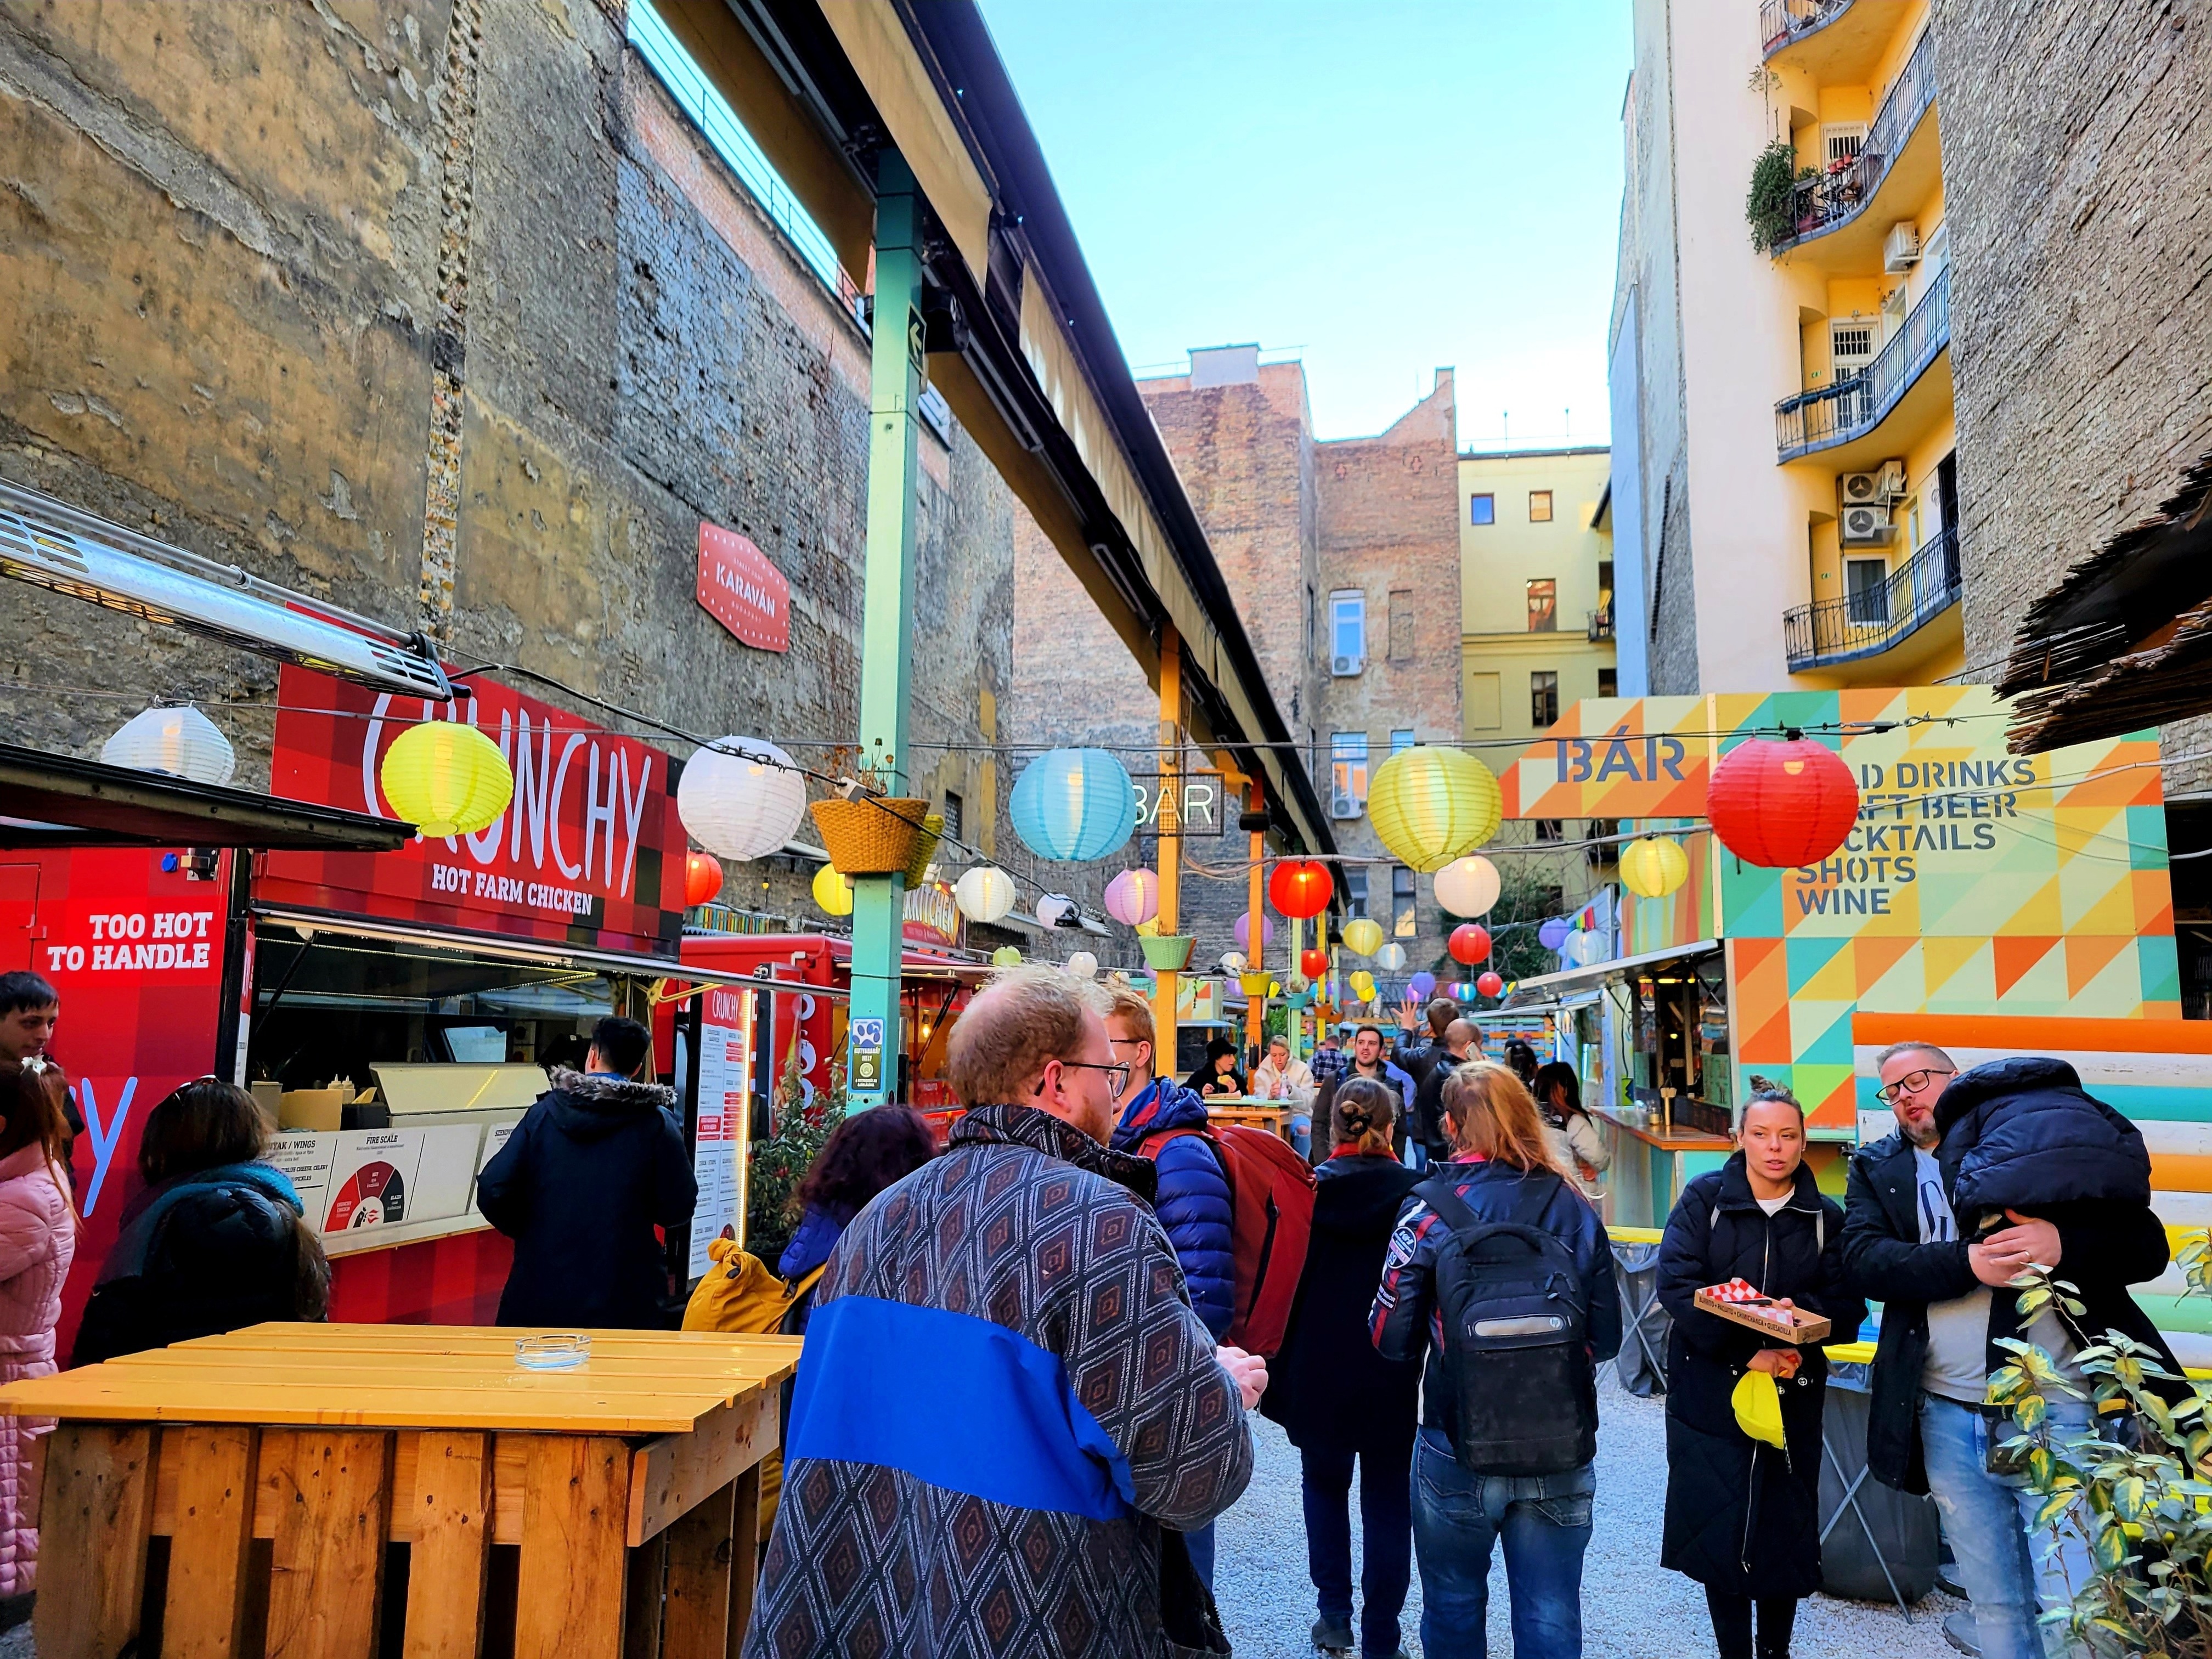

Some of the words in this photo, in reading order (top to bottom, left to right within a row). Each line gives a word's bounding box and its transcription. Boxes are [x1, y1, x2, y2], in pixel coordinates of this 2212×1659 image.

[716, 561, 775, 619] KARAVÁN
[1557, 725, 1685, 782] BÁR
[1897, 759, 2036, 788] DRINKS
[1922, 793, 2018, 819] BEER
[1844, 823, 1996, 852] CKTAILS
[1796, 856, 1916, 884] SHOTS
[432, 863, 471, 894] HOT
[475, 872, 524, 904] FARM
[527, 881, 592, 916] CHICKEN
[1796, 888, 1891, 915] WINE
[89, 913, 145, 939] TOO
[152, 912, 213, 939] HOT
[47, 945, 84, 971] TO
[91, 943, 210, 970] HANDLE
[713, 989, 740, 1023] CRUNCHY
[294, 1140, 315, 1149] WINGS
[366, 1136, 380, 1144] FIRE
[380, 1135, 398, 1143] SCALE
